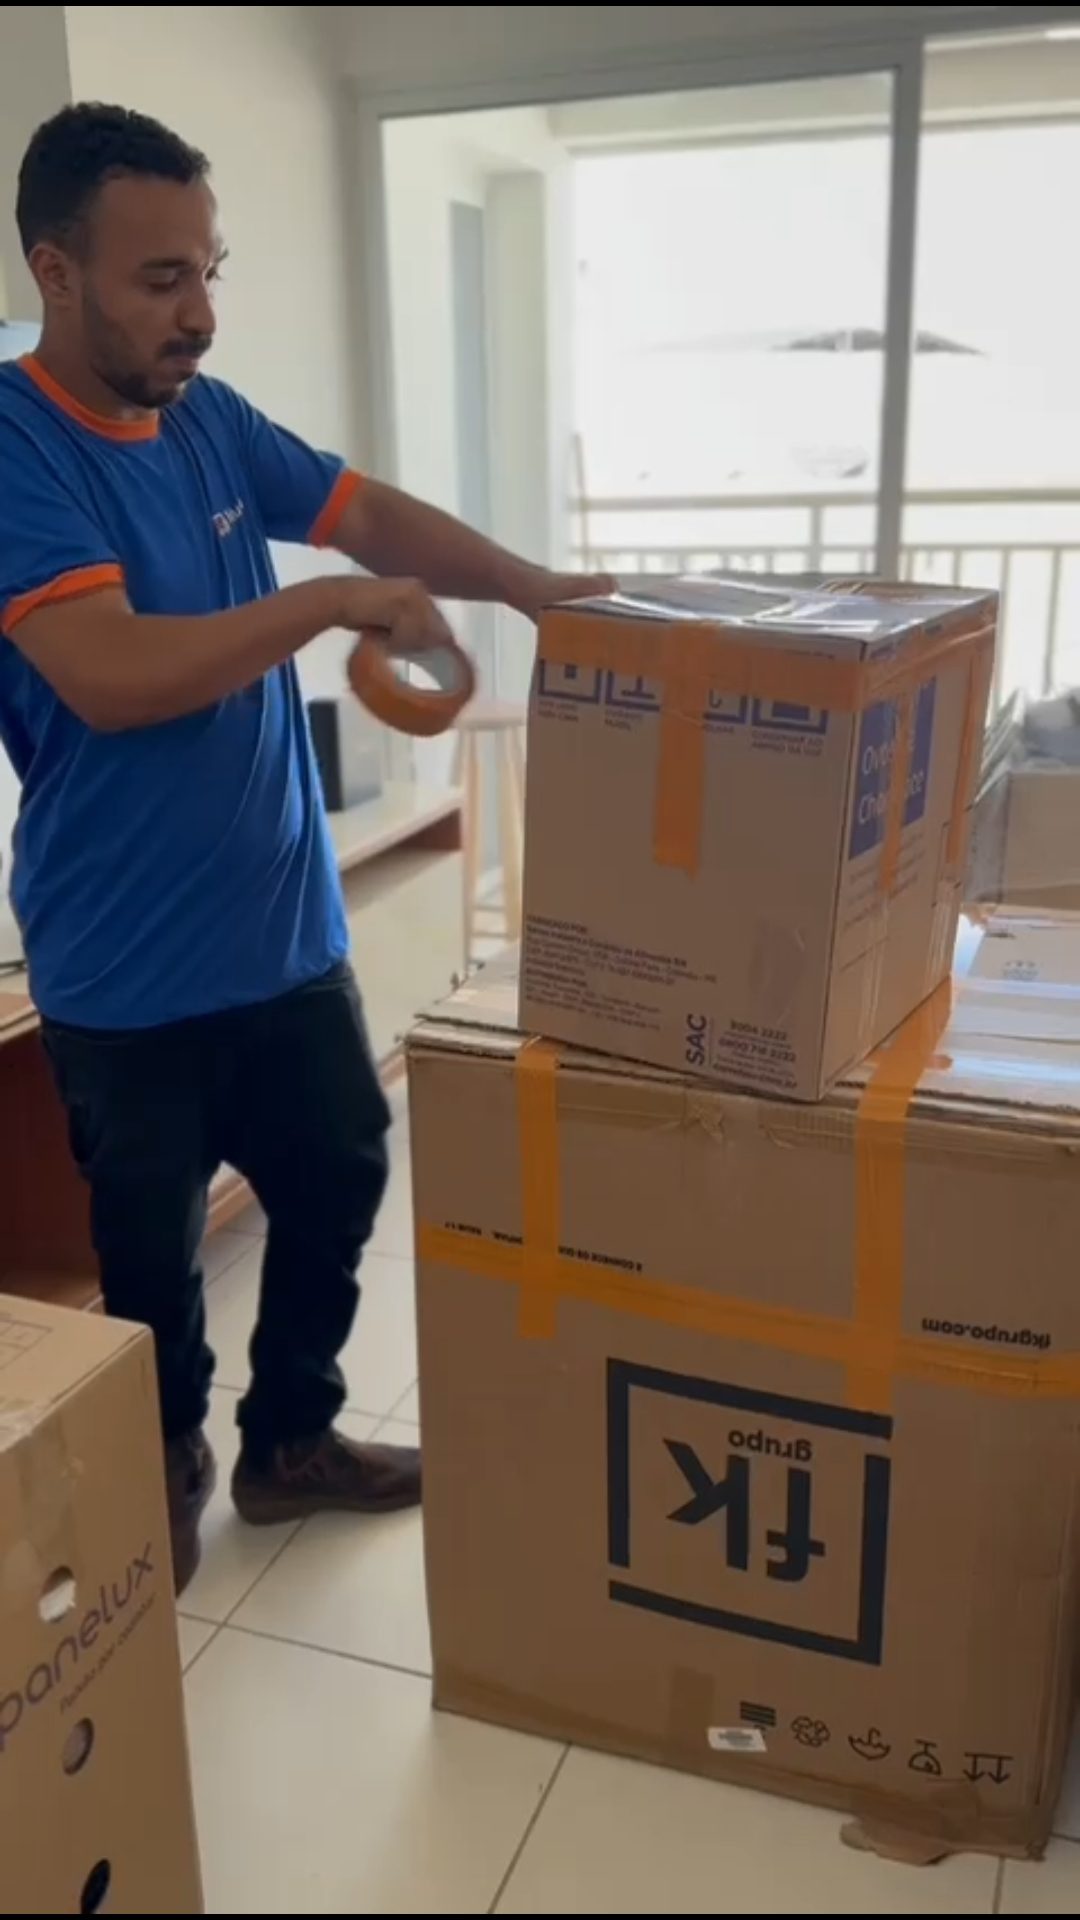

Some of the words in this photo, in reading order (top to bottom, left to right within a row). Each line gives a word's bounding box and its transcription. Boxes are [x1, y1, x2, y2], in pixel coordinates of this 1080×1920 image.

[686, 1013, 707, 1066] SAC
[922, 1317, 1052, 1349] fkgrupo.com
[728, 1429, 812, 1462] grupo
[662, 1437, 826, 1582] fk
[0, 1541, 154, 1755] panelux
